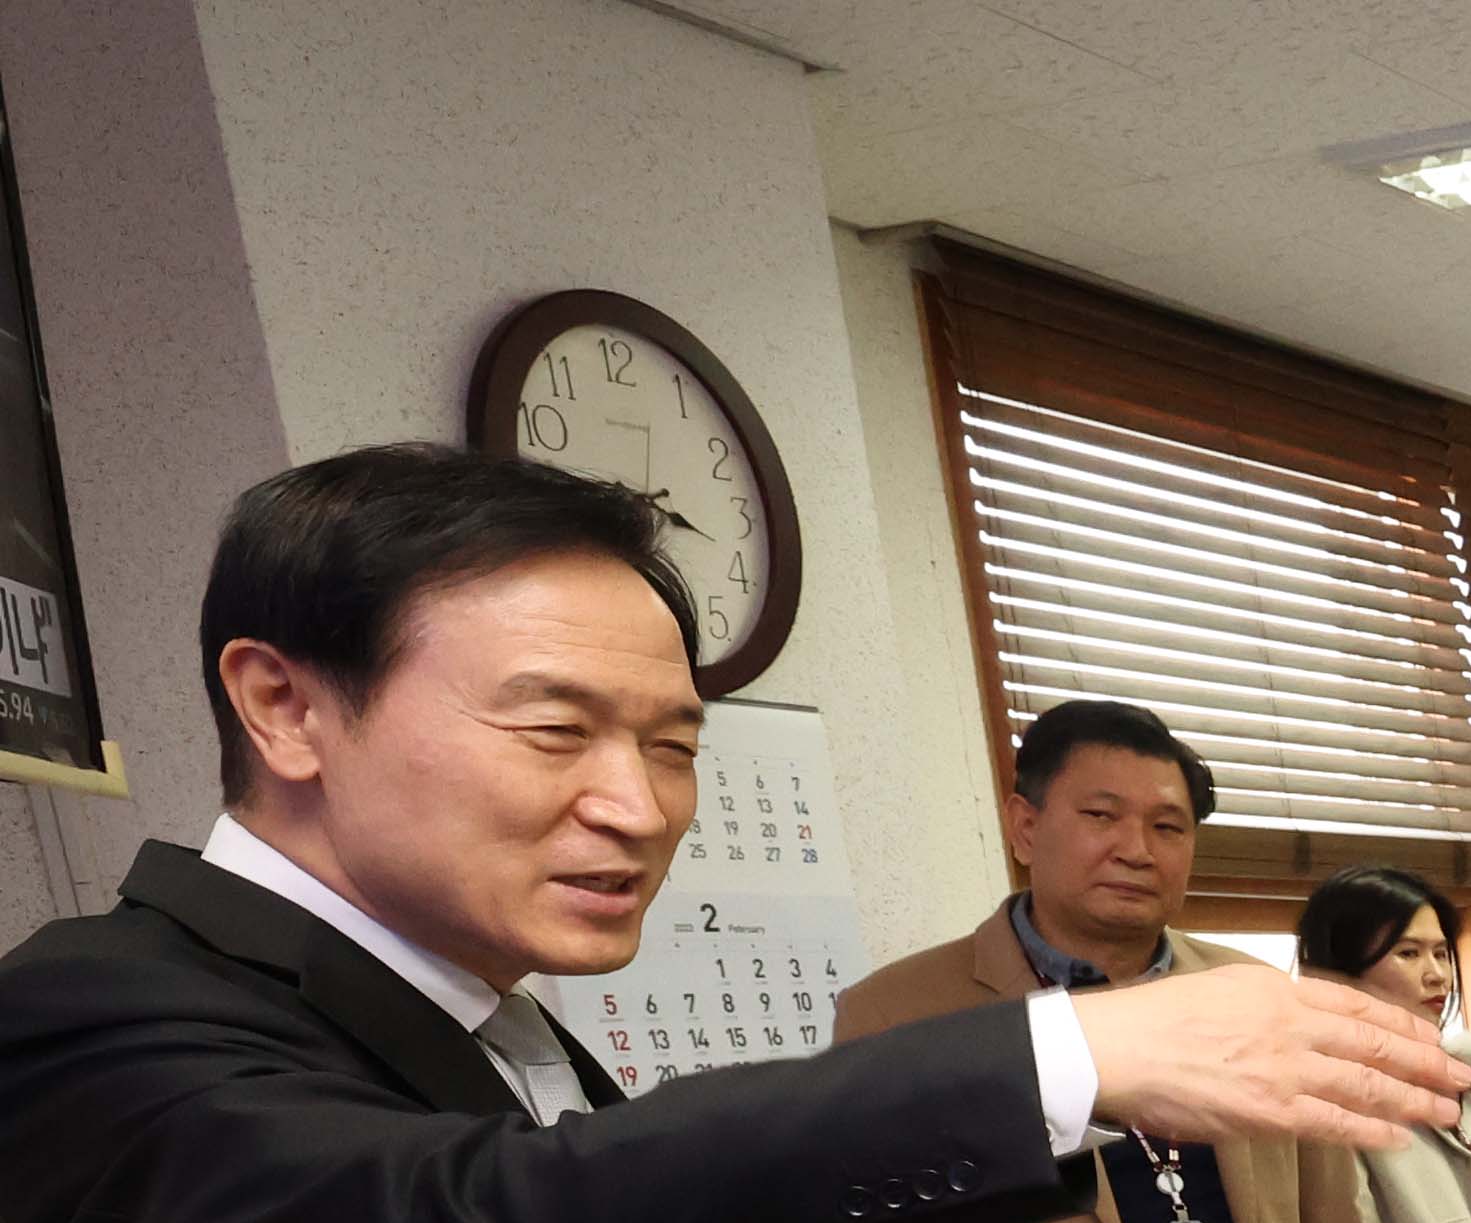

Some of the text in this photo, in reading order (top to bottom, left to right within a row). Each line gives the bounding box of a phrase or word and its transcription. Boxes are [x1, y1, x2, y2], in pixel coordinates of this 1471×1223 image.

[543, 351, 577, 400] 11
[598, 337, 637, 387] 12
[672, 373, 689, 419] 1
[519, 401, 568, 452] 10
[707, 437, 733, 482] 2
[729, 497, 753, 540] 3
[727, 550, 750, 594] 4
[707, 596, 730, 640] 5
[716, 770, 800, 791] 5 6 7
[719, 796, 810, 816] 12 13 14
[723, 821, 739, 835] 19
[760, 822, 777, 838] 20
[797, 824, 812, 840] 21
[688, 843, 818, 864] 25 26 27 28
[700, 903, 720, 932] 2
[716, 958, 838, 979] 1 2 3 4
[603, 994, 617, 1016] 5
[645, 994, 658, 1015] 6
[683, 993, 695, 1014] 7
[721, 993, 735, 1014] 8
[759, 992, 771, 1012] 9
[792, 992, 812, 1012] 10
[607, 1025, 817, 1052] 12 13 14 15 16 17
[616, 1066, 638, 1087] 19
